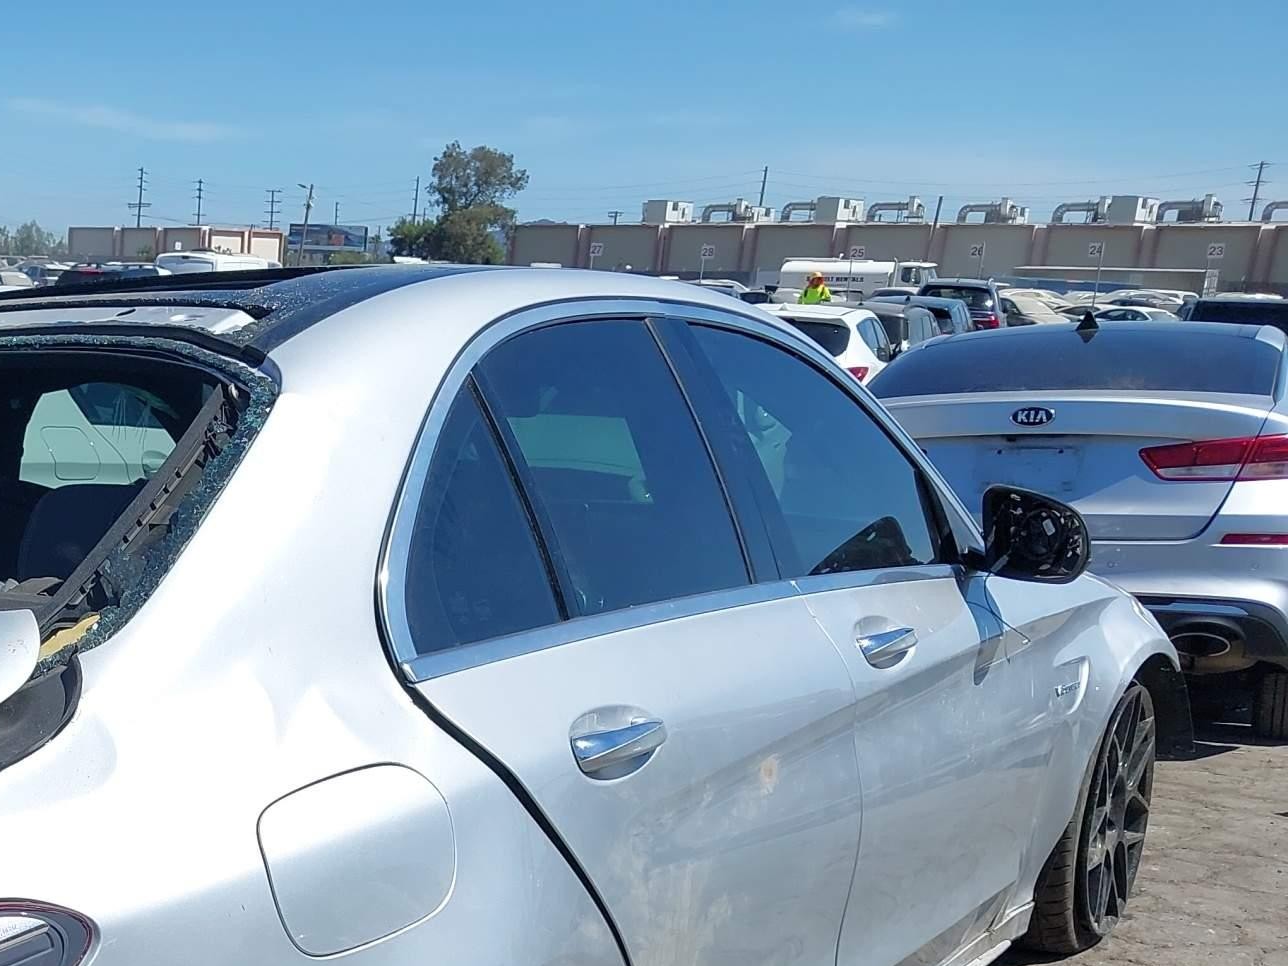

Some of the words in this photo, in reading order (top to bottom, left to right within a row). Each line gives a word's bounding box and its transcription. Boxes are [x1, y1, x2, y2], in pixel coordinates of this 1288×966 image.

[591, 245, 602, 255] 27
[851, 248, 864, 258] 25
[1208, 245, 1223, 256] 23
[1017, 410, 1047, 423] KIA
